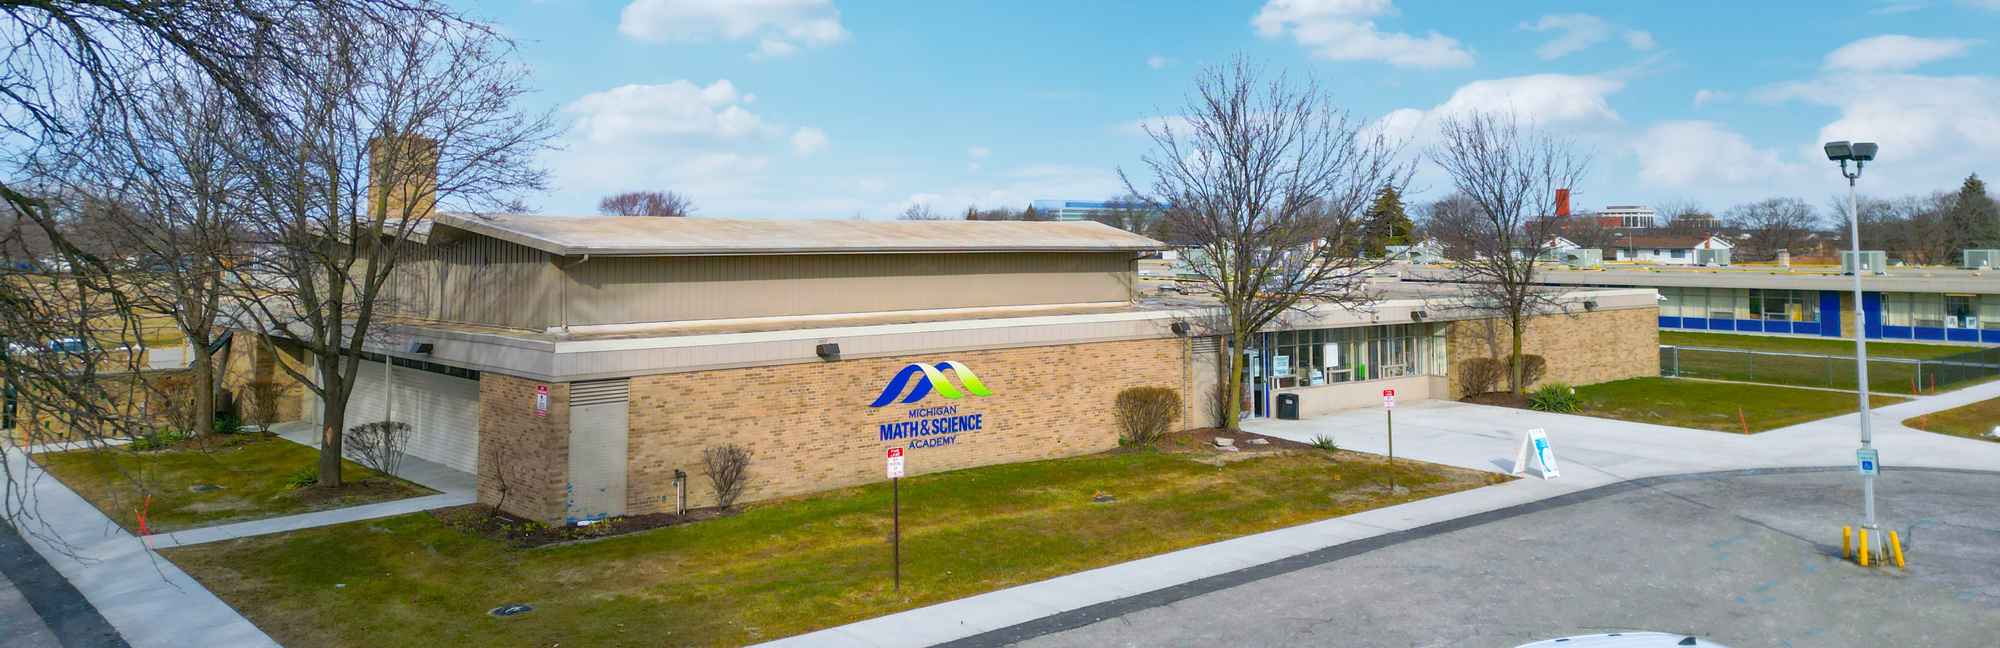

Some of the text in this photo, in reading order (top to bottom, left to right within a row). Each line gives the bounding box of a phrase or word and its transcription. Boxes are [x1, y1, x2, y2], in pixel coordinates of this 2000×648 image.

[908, 406, 957, 418] MICHIGAN
[880, 421, 918, 440] MATH
[931, 414, 982, 434] SCIENCE
[909, 436, 956, 449] ACADEMY
